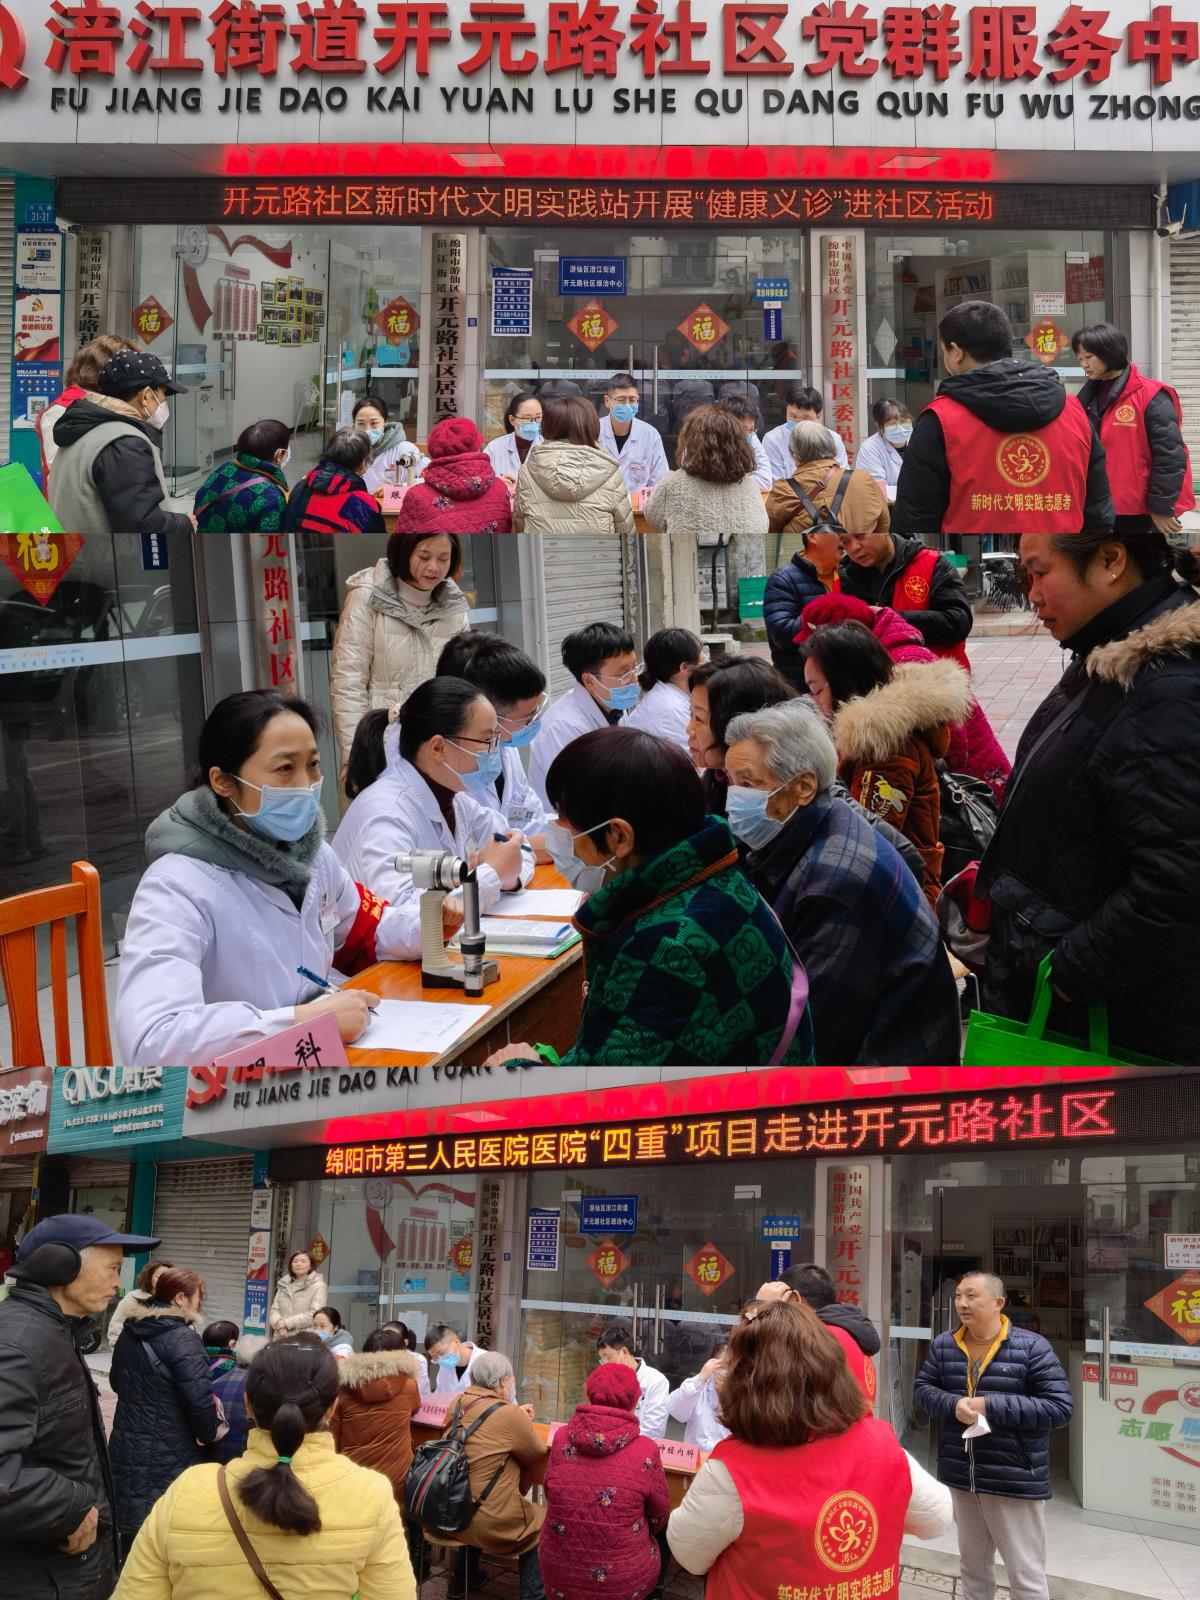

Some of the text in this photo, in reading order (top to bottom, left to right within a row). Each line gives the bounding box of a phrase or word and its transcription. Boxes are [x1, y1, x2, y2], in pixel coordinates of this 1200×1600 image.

[44, 0, 1200, 85] 涪江街道开元路社区党群服务中
[50, 86, 1200, 121] FU JIANG JIE DAO KAI YUAN LU SHE QU DANG QUN FU WU ZHONG
[222, 185, 994, 221] 开元路社区新时代文明实践站开展“健康义诊”进社区活动
[449, 239, 461, 292] 绵阳市游仙区
[828, 241, 840, 295] 绵阳市游仙区
[842, 241, 853, 295] 中国共产党
[139, 308, 160, 333] 福
[387, 309, 410, 334] 福
[581, 313, 604, 338] 福
[692, 316, 716, 341] 福
[1036, 328, 1057, 353] 福
[971, 493, 1072, 512] 新时代文明实践志愿者
[17, 533, 59, 572] 福
[233, 1092, 250, 1109] FU
[256, 1082, 300, 1106] JIANG
[307, 1077, 331, 1098] JIE
[338, 1070, 376, 1094] DAO
[386, 1066, 418, 1087] KAI
[325, 1091, 1116, 1177] 绵阳市第三人民医院医院“四重”项目走进开元路社区
[832, 1172, 846, 1235] 绵阳市游仙区
[849, 1172, 862, 1236] 中国共产党
[311, 1242, 324, 1260] 福
[458, 1244, 473, 1265] 福
[597, 1251, 617, 1274] 福
[697, 1256, 721, 1283] 福
[1170, 1289, 1200, 1324] 福
[777, 1563, 895, 1600] 新时代文明实践志愿
